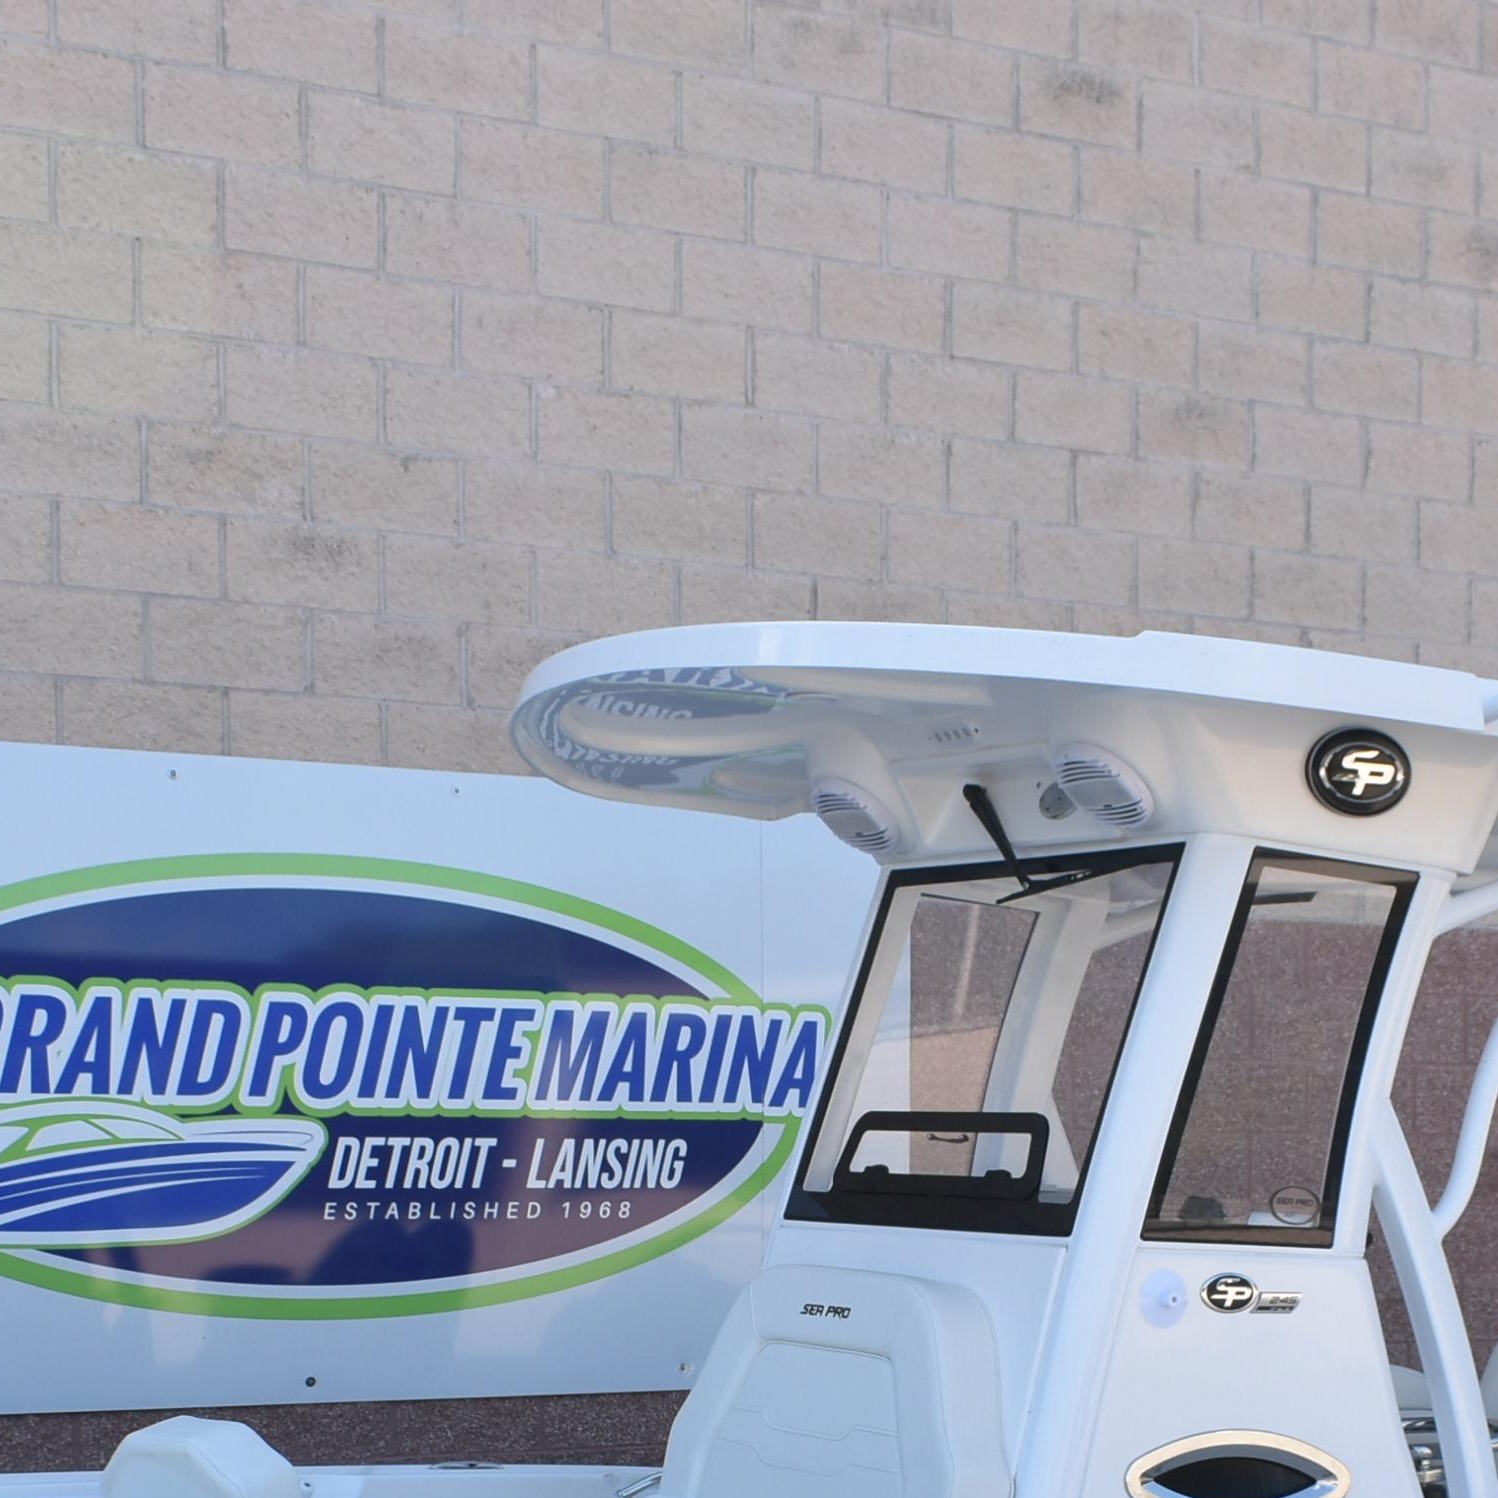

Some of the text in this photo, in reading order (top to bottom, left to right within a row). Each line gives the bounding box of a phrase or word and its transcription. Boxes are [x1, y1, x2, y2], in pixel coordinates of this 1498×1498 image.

[246, 999, 537, 1102] POINTE
[535, 1006, 823, 1111] MARINA
[327, 1136, 498, 1190] DETROIT
[525, 1137, 688, 1191] LANSING
[323, 1200, 632, 1220] ESTABLISHED 1968
[799, 1303, 851, 1320] SEA PRO
